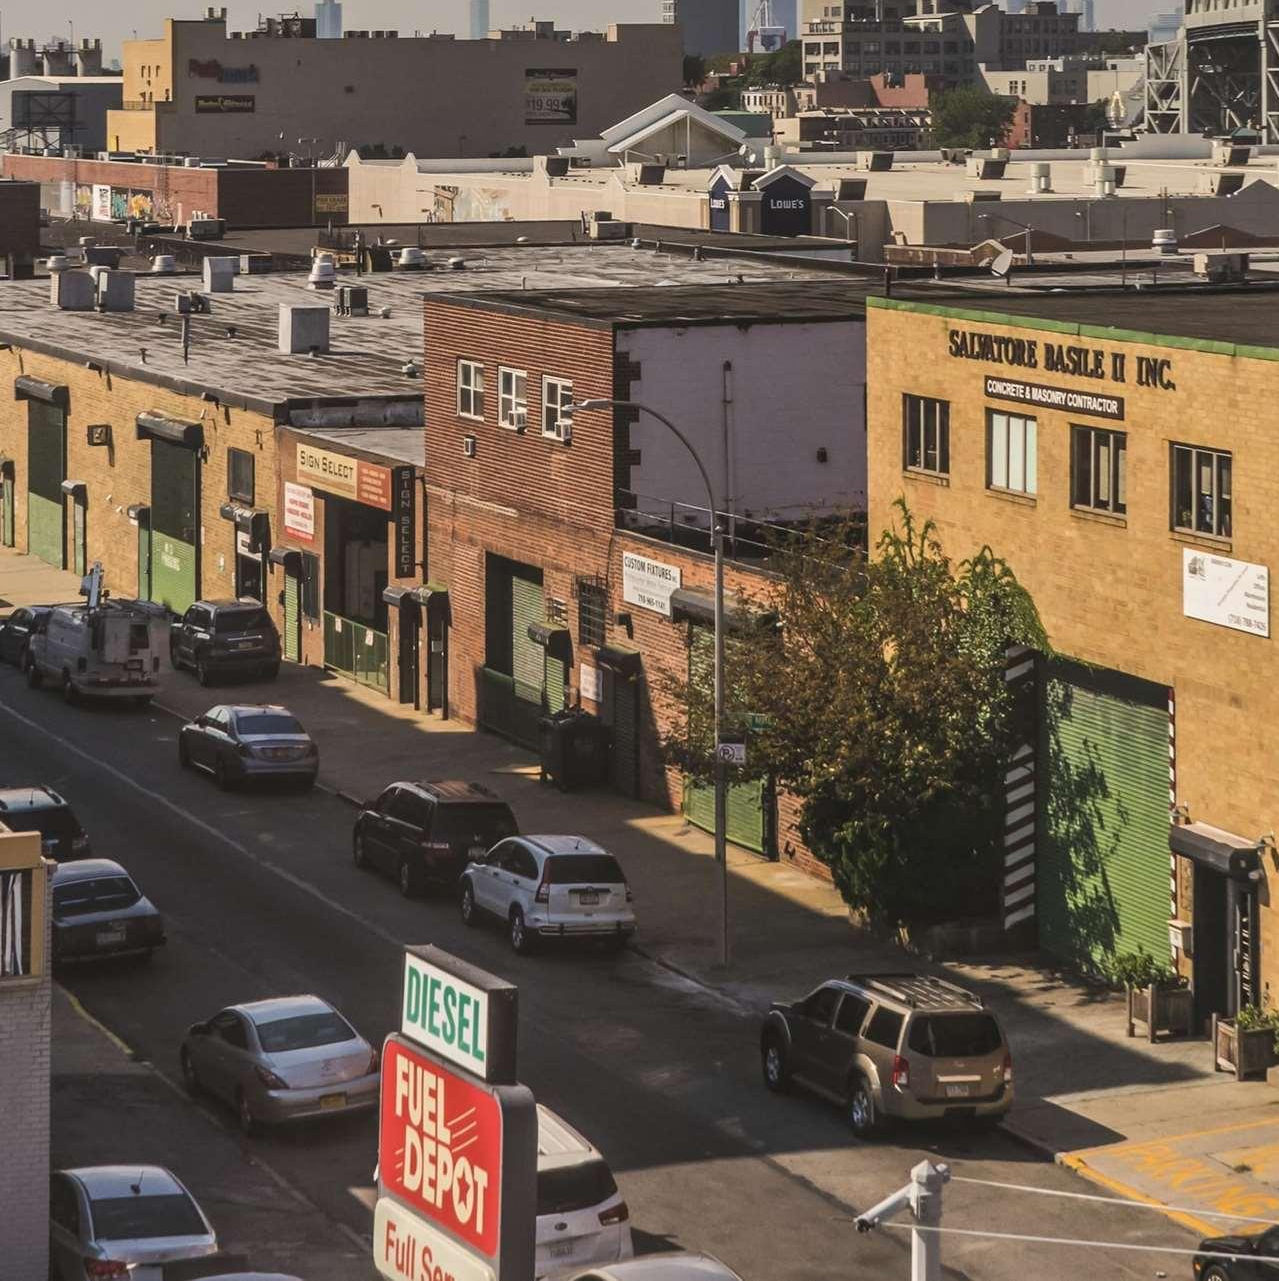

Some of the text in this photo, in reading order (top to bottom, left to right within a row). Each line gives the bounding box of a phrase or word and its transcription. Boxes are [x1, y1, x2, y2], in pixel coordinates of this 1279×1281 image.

[770, 199, 804, 209] LOWE'S
[948, 329, 1176, 391] SALVATORE BASILE II INC.
[987, 380, 1118, 414] CONCRETE & MASONRY CONTRACTOR
[300, 450, 354, 479] SIGN SELECT
[401, 470, 410, 573] SIGN SELECT
[625, 556, 646, 572] CUSTOM
[647, 563, 672, 581] FIXTURES
[406, 965, 485, 1061] DIESEL
[395, 1054, 451, 1144] FUEL
[403, 1125, 488, 1236] DEPOT
[385, 1219, 416, 1280] Full
